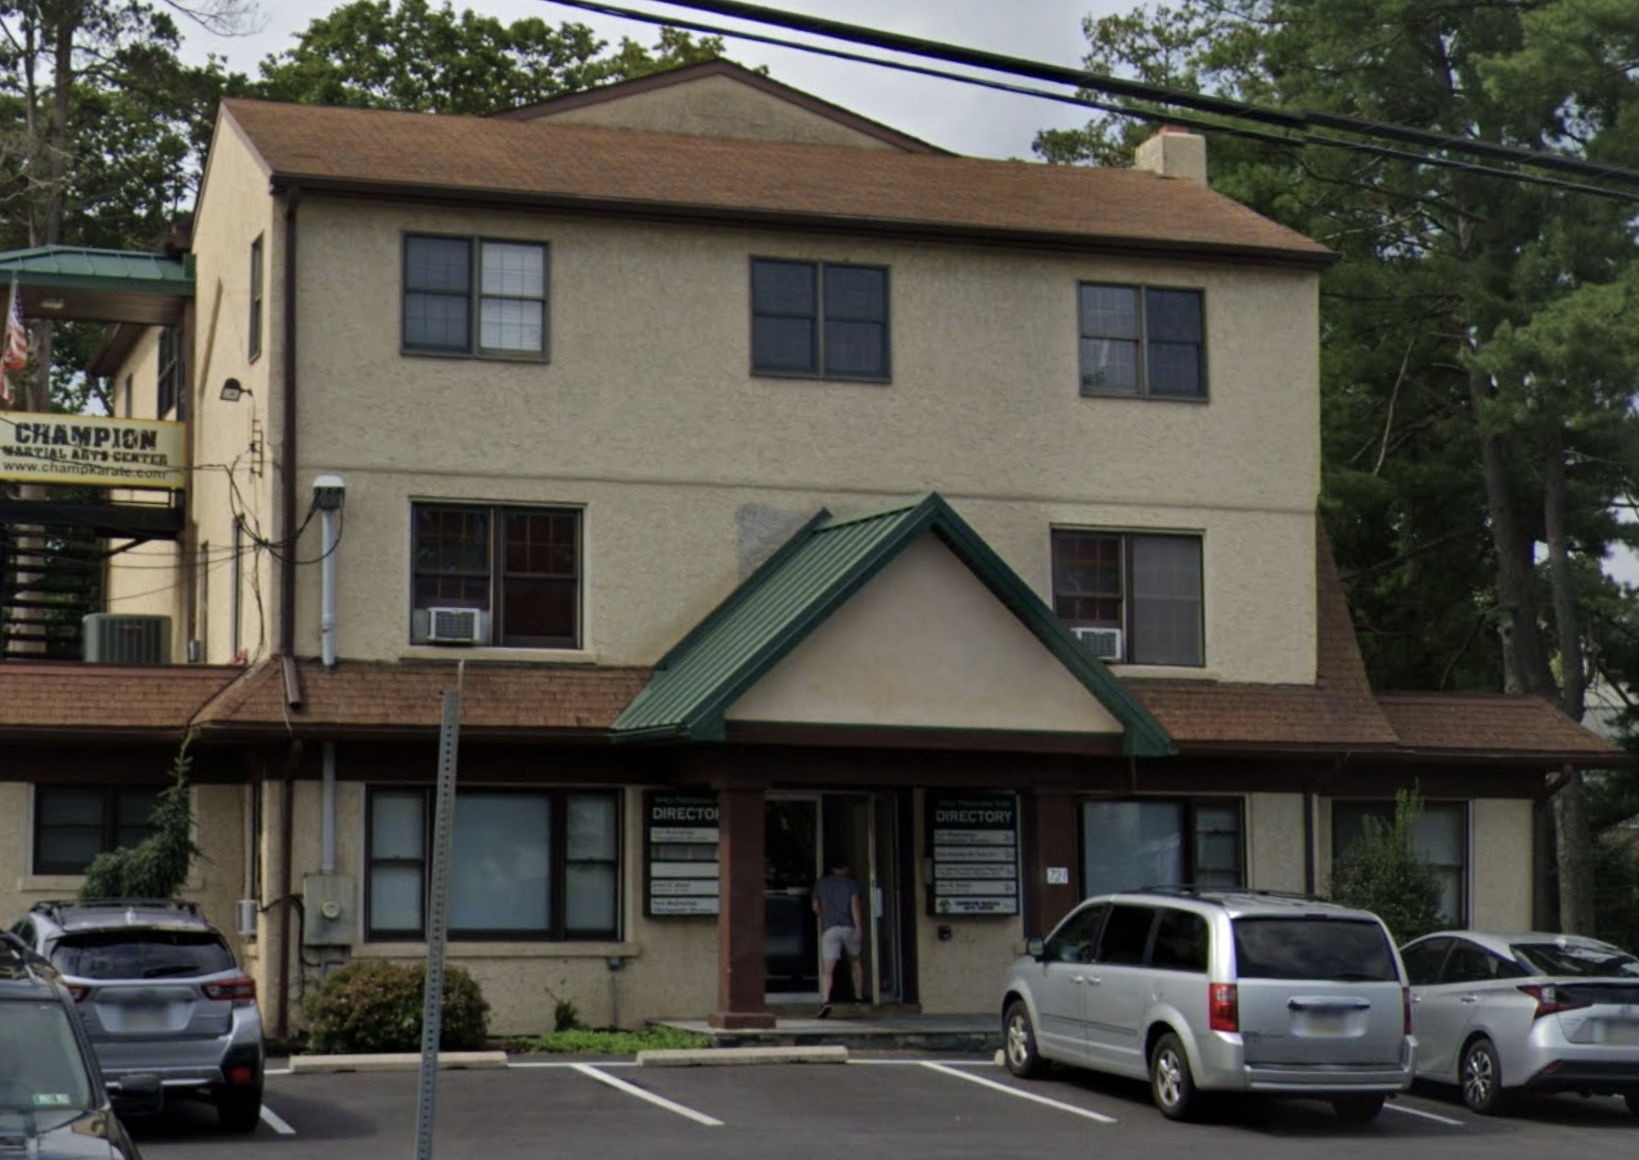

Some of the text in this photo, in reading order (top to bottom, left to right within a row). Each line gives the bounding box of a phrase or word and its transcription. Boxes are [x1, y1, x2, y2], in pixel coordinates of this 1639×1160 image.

[14, 422, 158, 450] CHAMPION
[3, 445, 167, 466] MARTIAL ARTS CENTER
[652, 807, 719, 820] DIRECTO
[936, 809, 1012, 823] DIRECTORY
